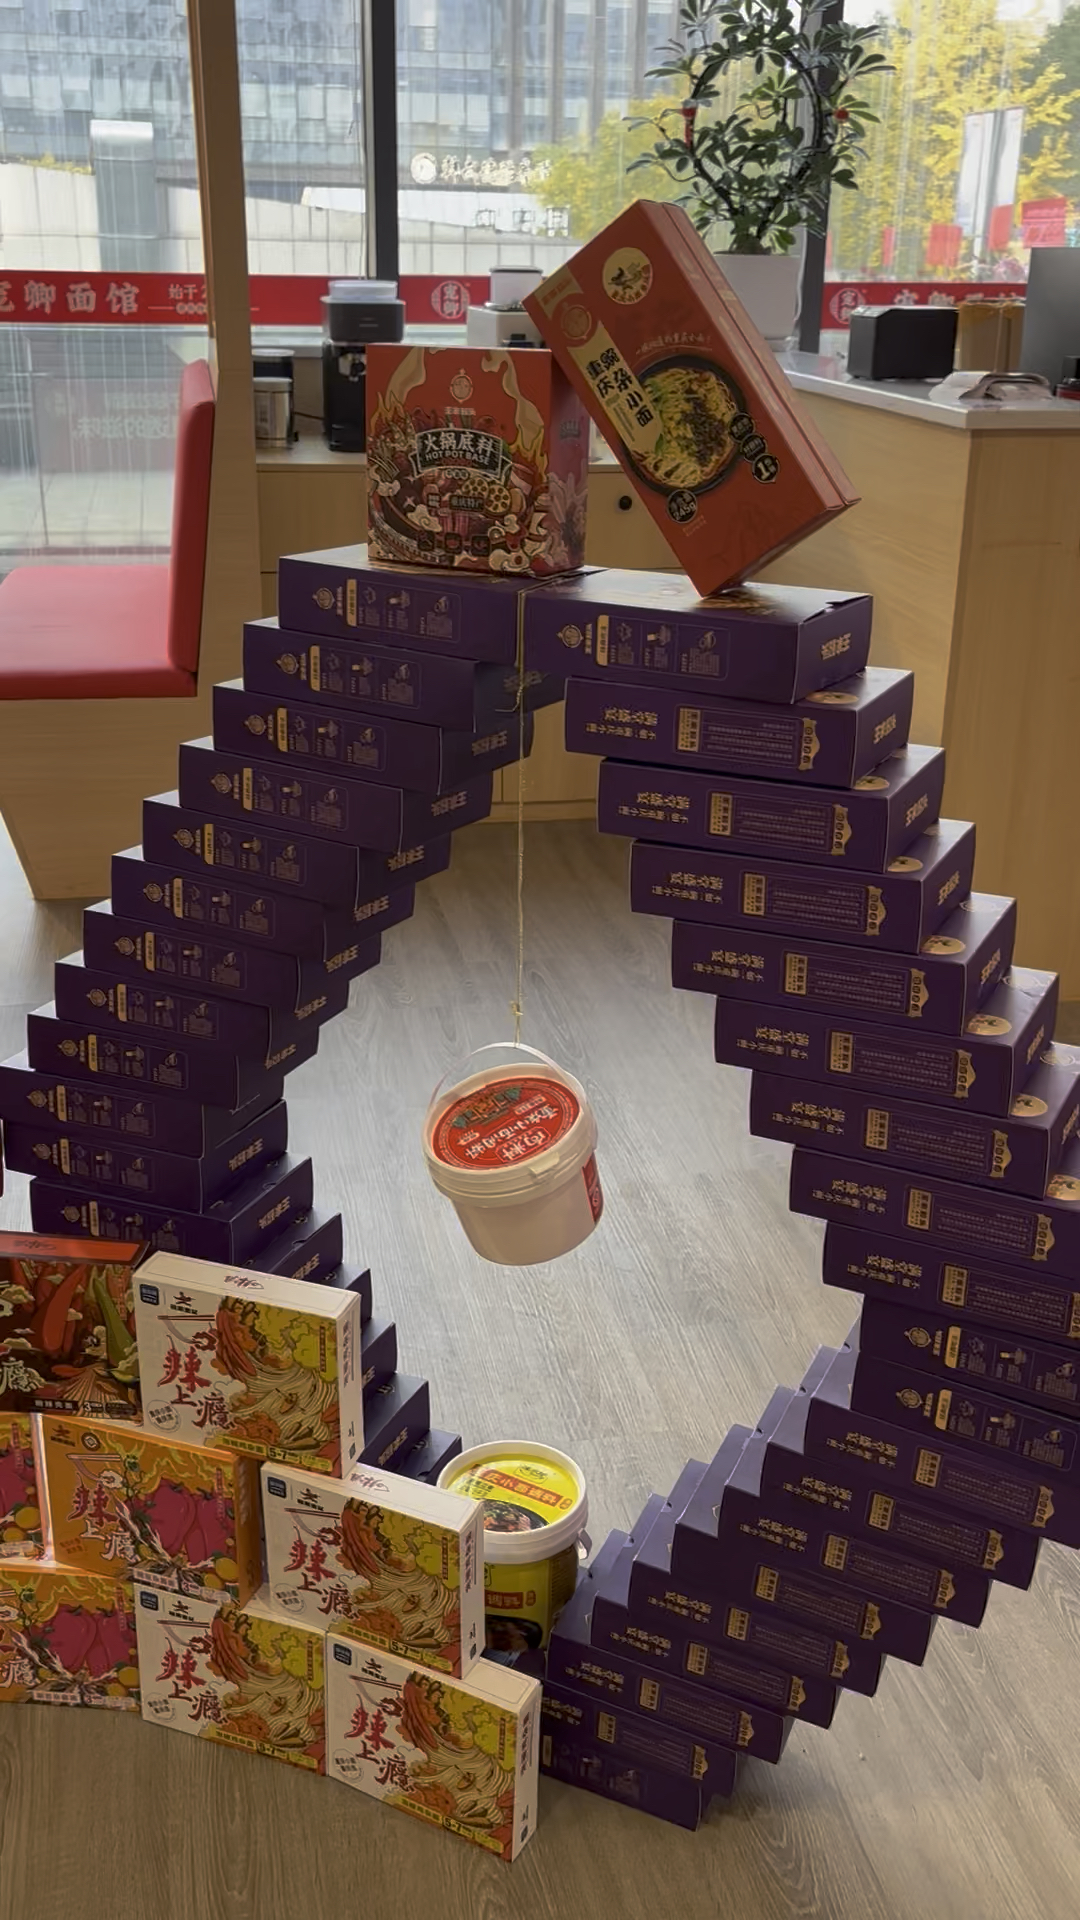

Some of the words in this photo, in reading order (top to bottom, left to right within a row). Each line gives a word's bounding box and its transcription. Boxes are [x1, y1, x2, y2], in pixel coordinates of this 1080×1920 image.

[424, 431, 494, 456] 火锅底料
[425, 451, 443, 462] HOT
[444, 450, 464, 459] POT
[465, 452, 490, 465] BASE
